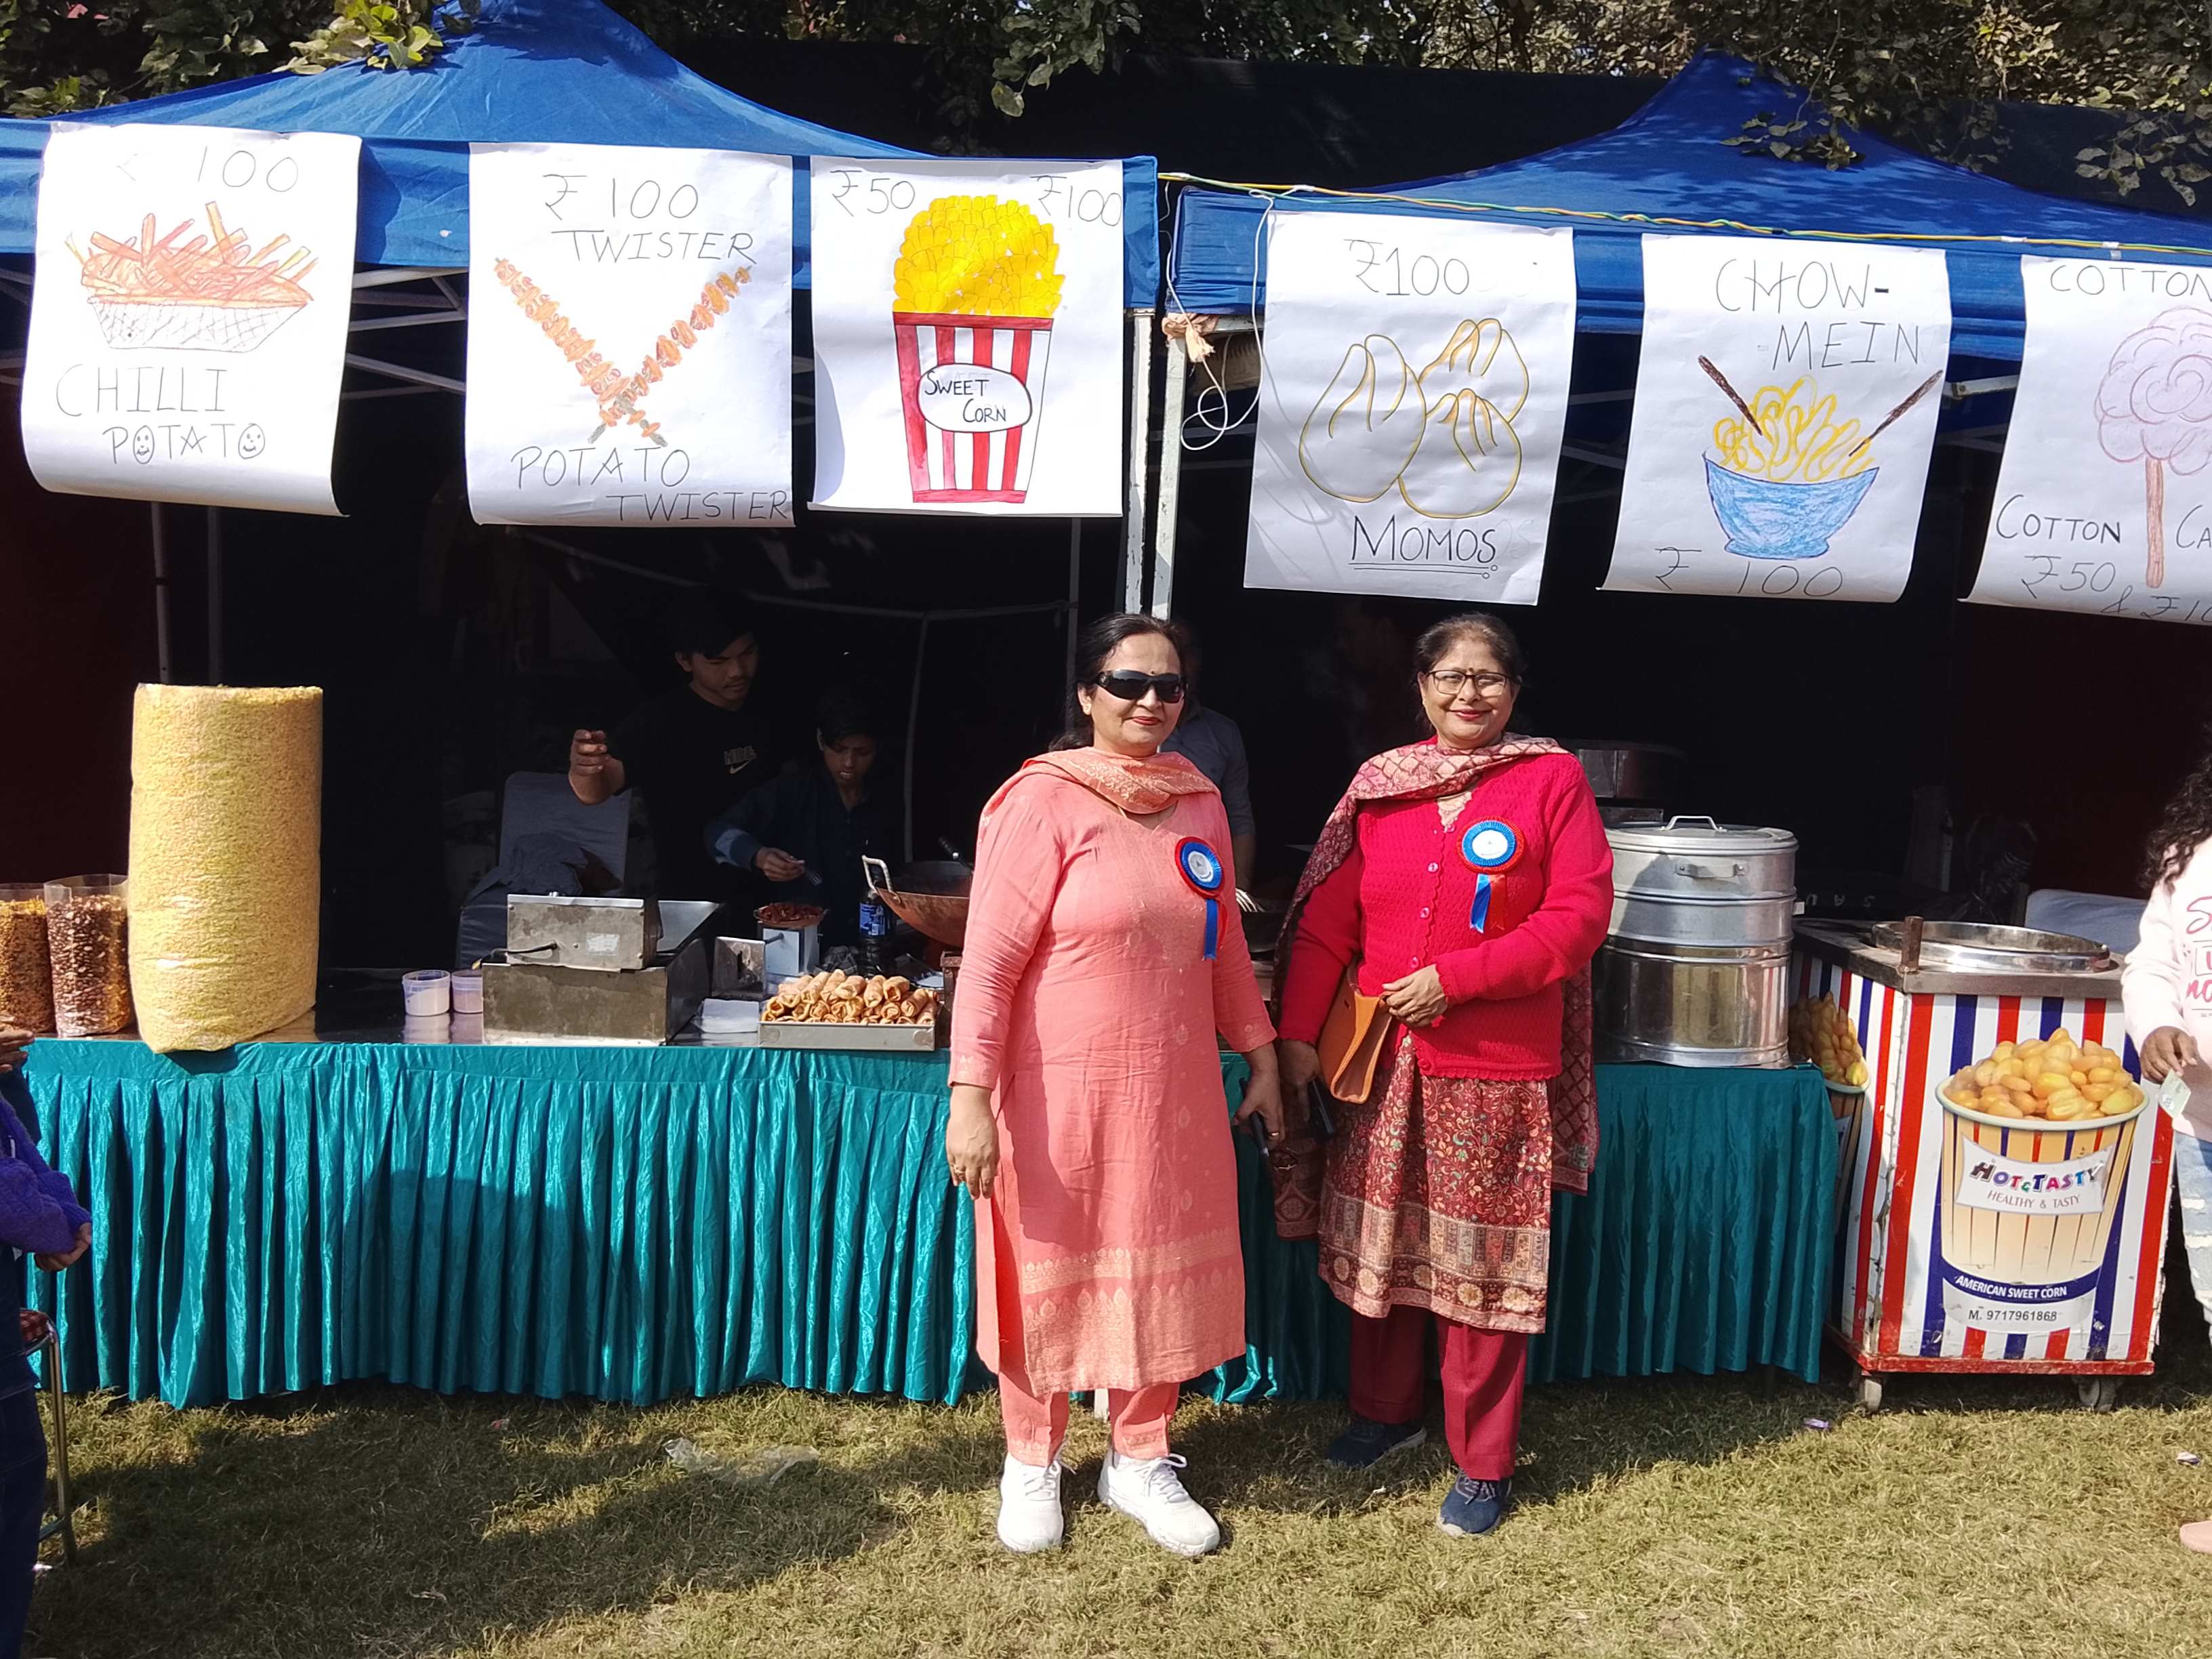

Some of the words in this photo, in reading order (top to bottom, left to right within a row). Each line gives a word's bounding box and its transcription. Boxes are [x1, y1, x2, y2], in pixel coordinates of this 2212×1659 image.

[830, 169, 916, 217] ₹50
[1030, 175, 1122, 226] ₹100
[551, 230, 757, 264] TWISTER
[1343, 239, 1470, 295] ₹100
[2050, 264, 2212, 302] COTTON
[1773, 321, 1919, 371] MEIN
[56, 364, 228, 417] CHILLI
[924, 369, 989, 396] SWEET
[962, 398, 1007, 424] CORN
[102, 423, 266, 465] POTATO
[510, 445, 690, 489] POTATO
[606, 489, 790, 521] TWISTER
[1996, 495, 2121, 544] COTTON
[1351, 515, 1496, 564] MOMOS
[2021, 556, 2116, 599] ₹50
[1988, 1190, 2034, 1208] HEALTHY
[2039, 1200, 2047, 1209] &
[2053, 1195, 2081, 1209] TASTY
[1955, 1275, 2007, 1297] AMERICAN
[2007, 1288, 2039, 1298] SWEET
[2041, 1286, 2067, 1298] CORN
[1968, 1310, 1982, 1320] M.
[1986, 1310, 2057, 1322] 9717961868
